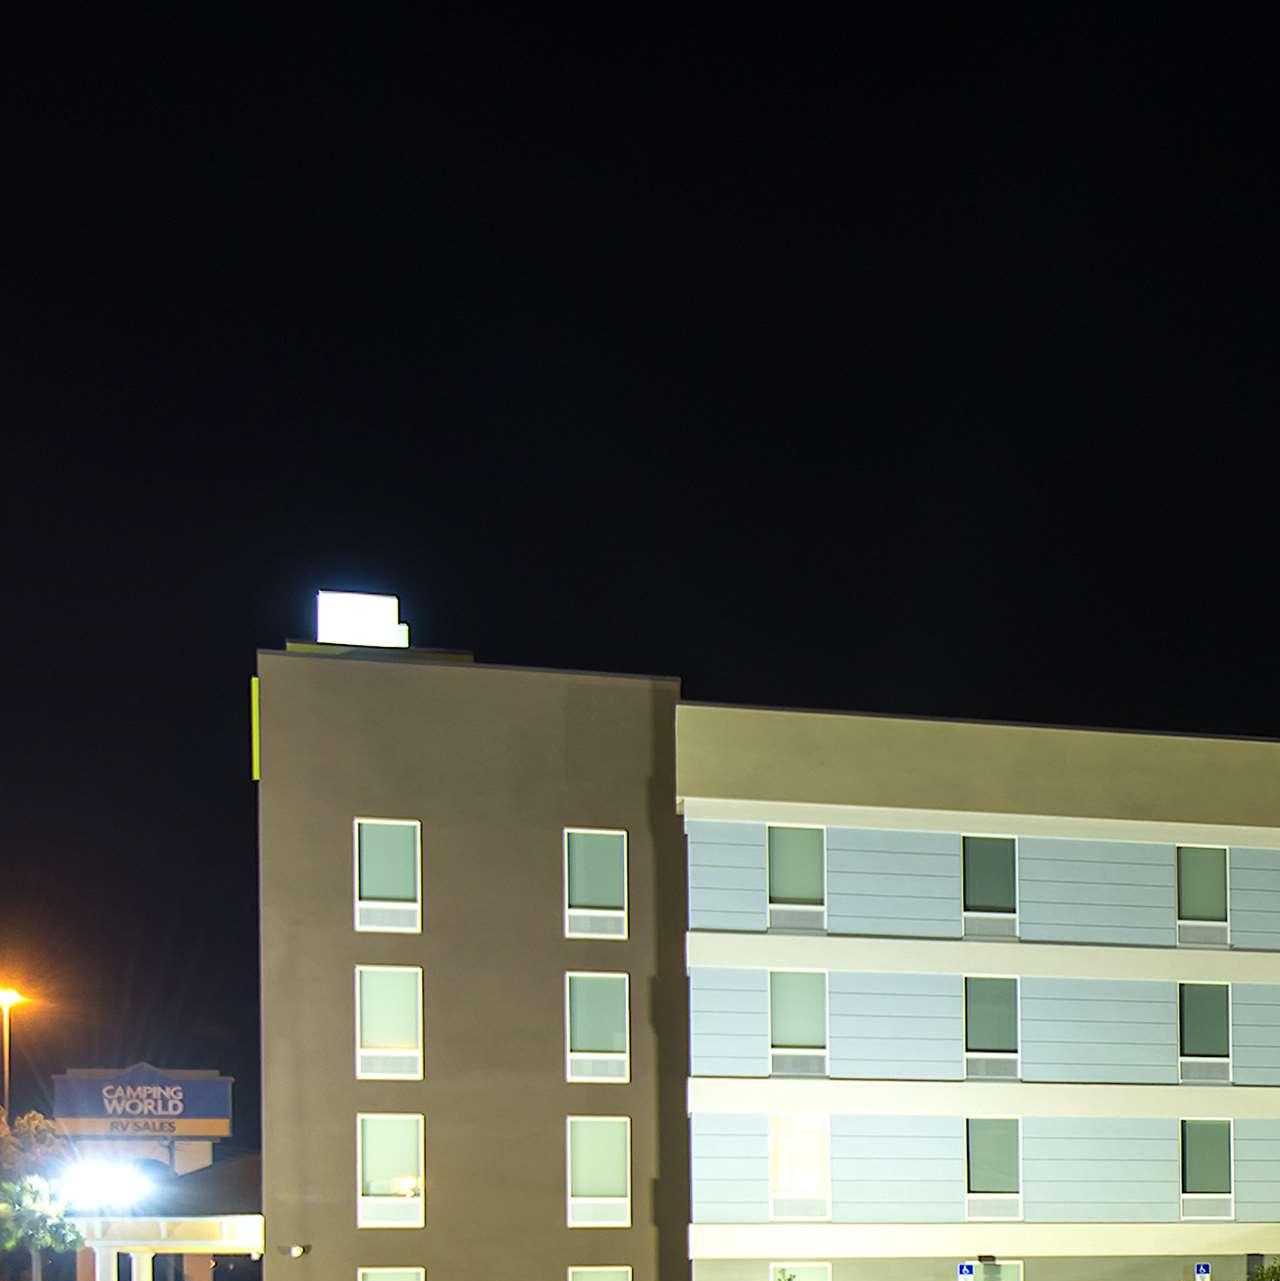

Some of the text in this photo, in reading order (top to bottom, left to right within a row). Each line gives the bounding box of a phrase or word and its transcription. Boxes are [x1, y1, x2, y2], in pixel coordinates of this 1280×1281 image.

[102, 1085, 184, 1100] CAMPING
[103, 1099, 184, 1116] WORLD
[110, 1121, 176, 1133] RV SALES
